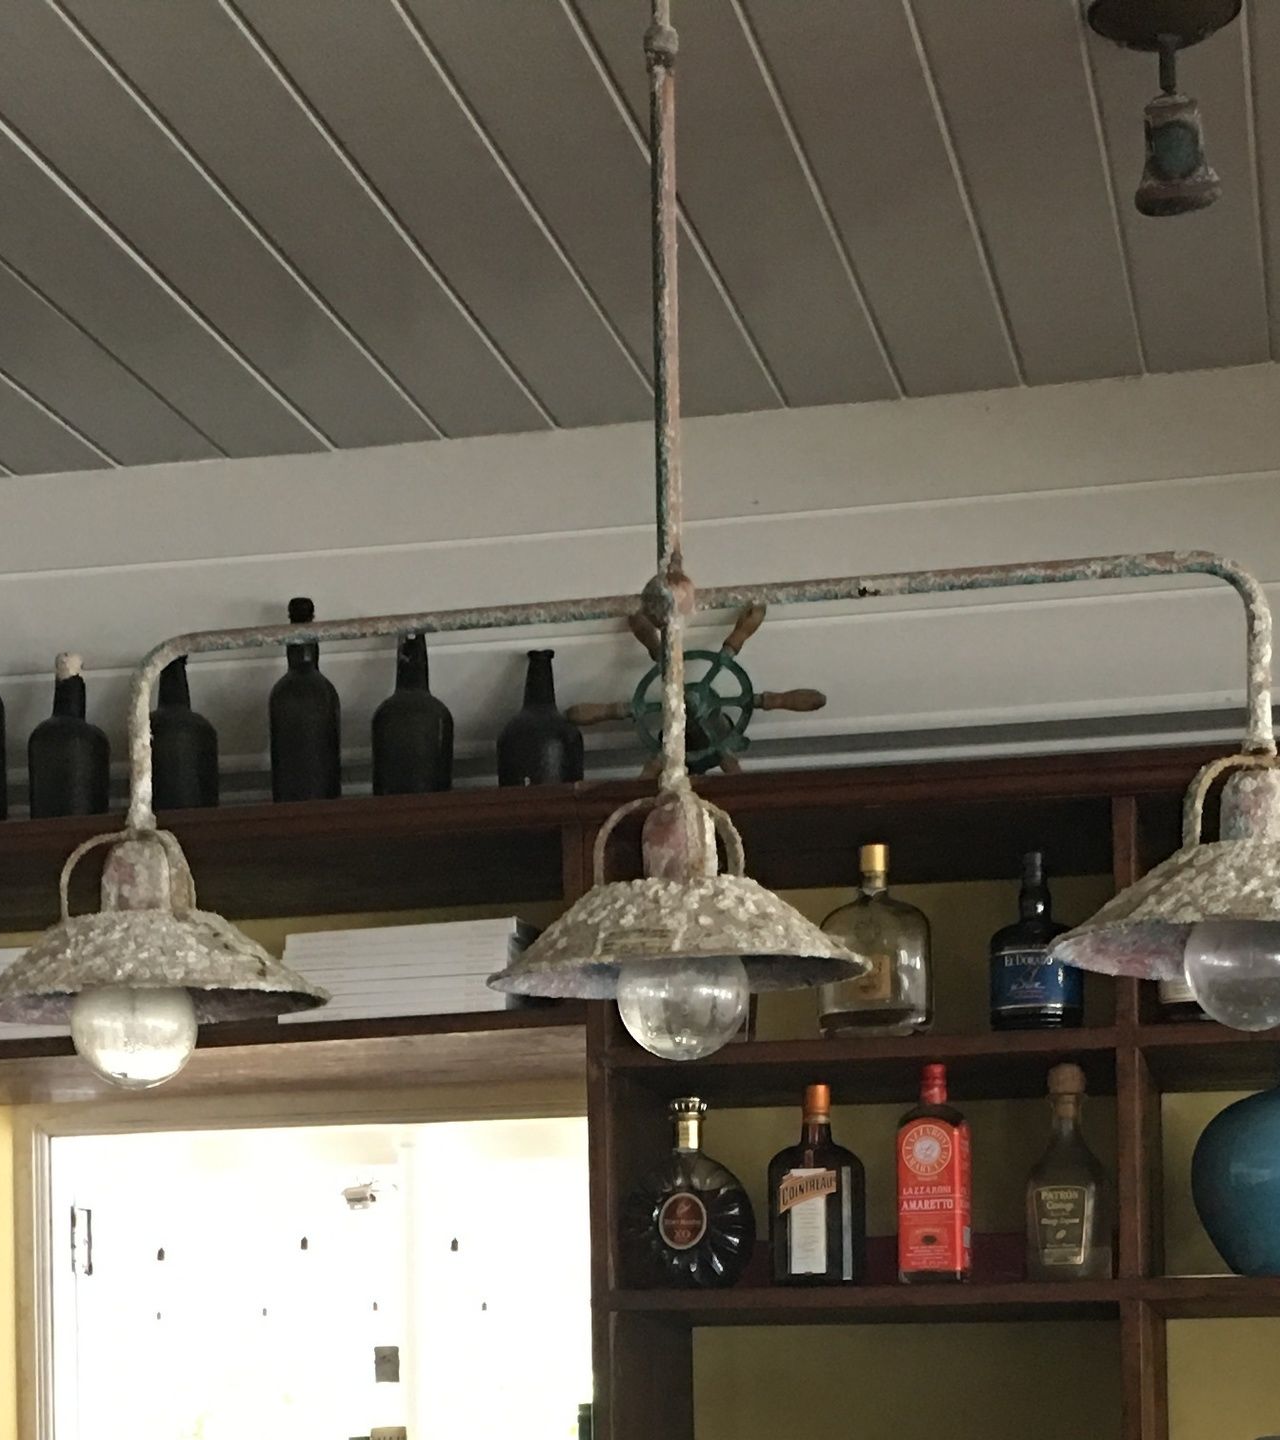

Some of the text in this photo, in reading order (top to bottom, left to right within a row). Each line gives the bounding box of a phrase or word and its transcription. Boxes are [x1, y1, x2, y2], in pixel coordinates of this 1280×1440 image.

[782, 1176, 833, 1206] COINTREAU
[902, 1185, 952, 1196] LAZZARONI
[901, 1198, 955, 1211] AMARETTO
